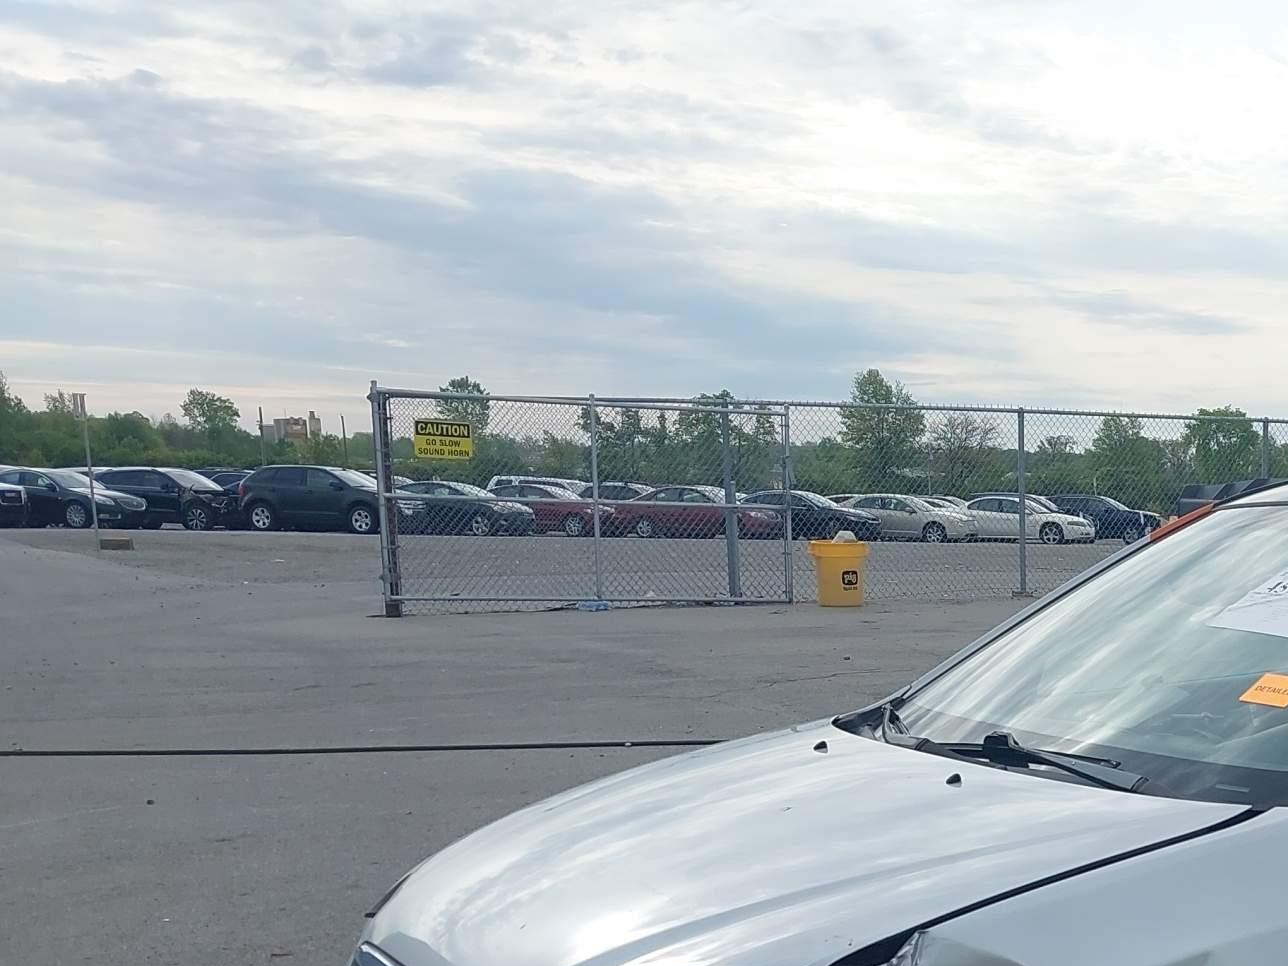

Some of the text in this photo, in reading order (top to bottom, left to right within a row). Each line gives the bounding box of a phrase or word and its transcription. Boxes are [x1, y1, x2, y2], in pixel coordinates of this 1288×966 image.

[417, 423, 468, 436] CAUTION
[425, 438, 460, 448] GO SLOW
[447, 449, 469, 457] HORN
